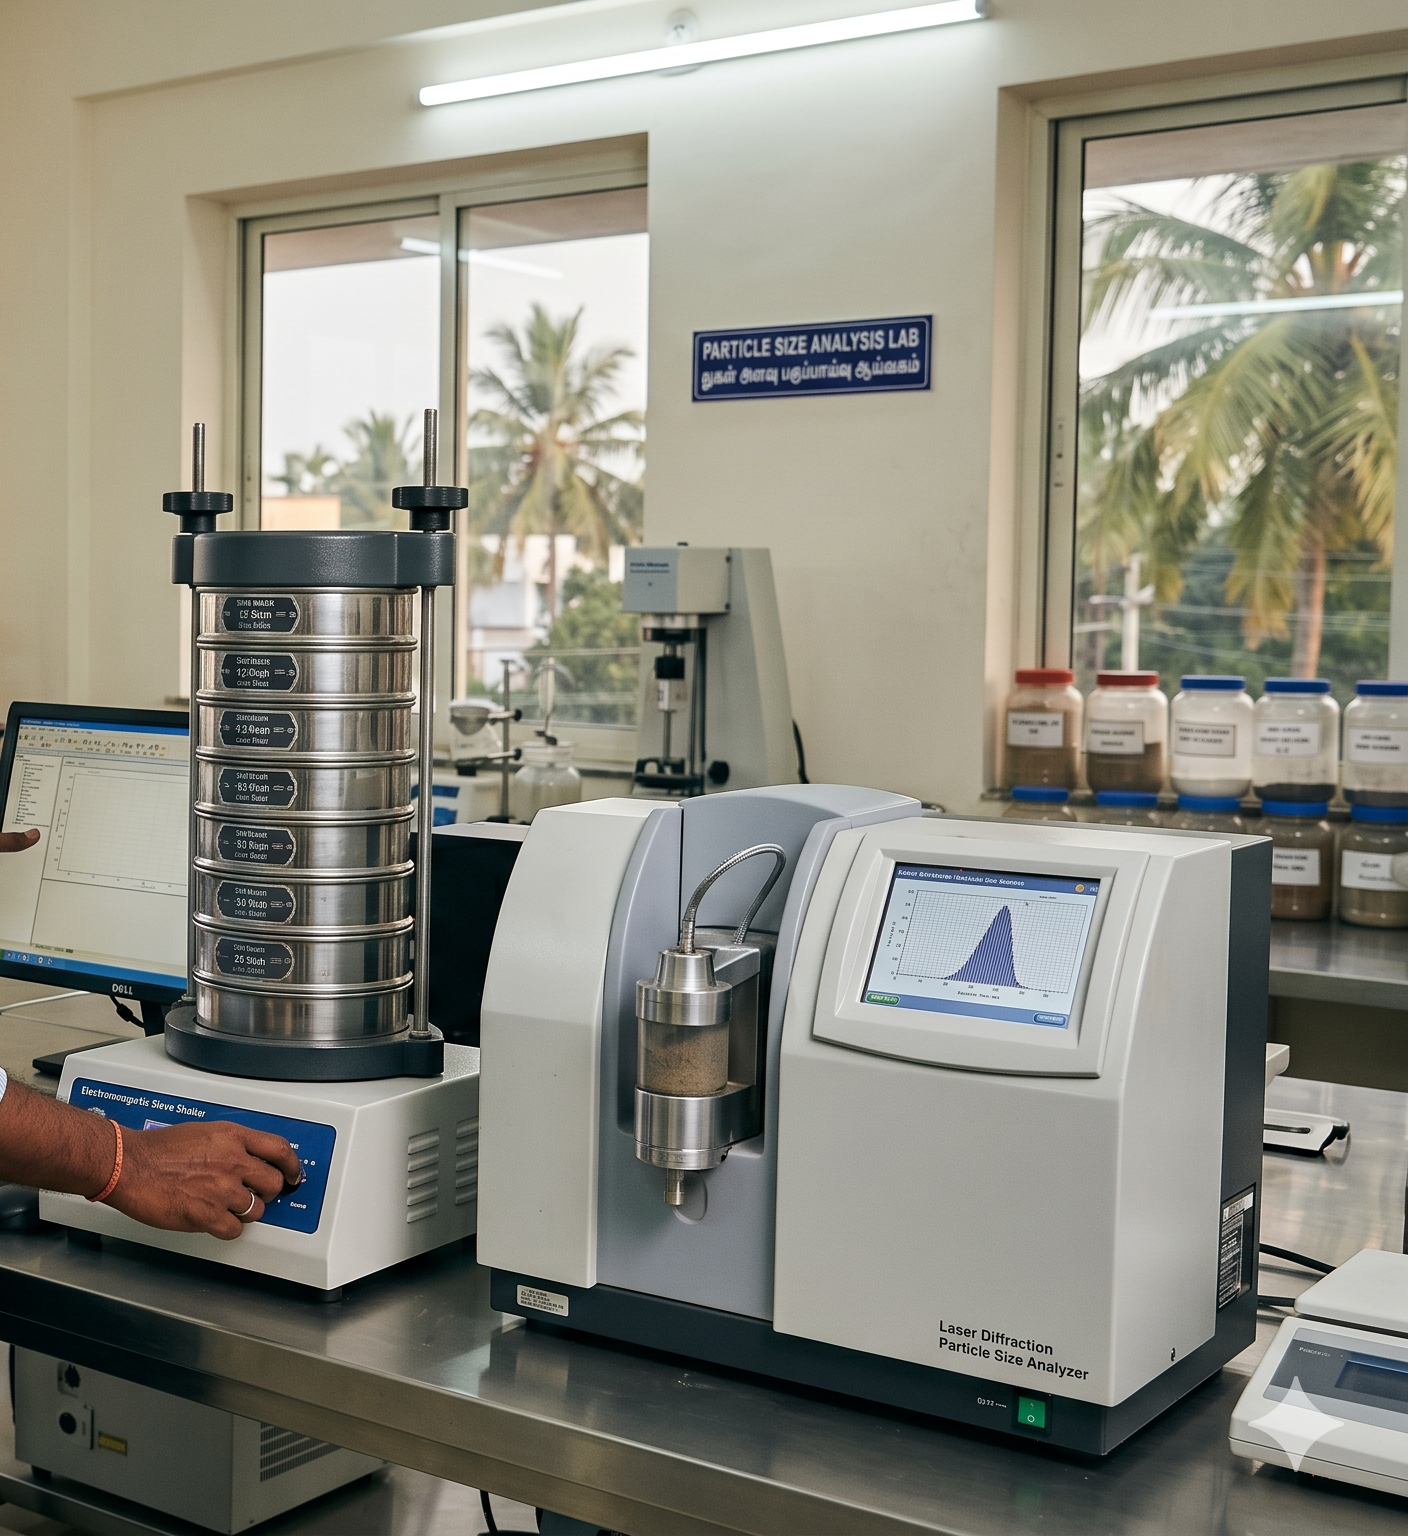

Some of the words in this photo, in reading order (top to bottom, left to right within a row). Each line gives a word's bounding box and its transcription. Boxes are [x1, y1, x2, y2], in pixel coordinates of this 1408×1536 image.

[702, 339, 772, 360] PARTICLE
[775, 335, 807, 356] SIZE
[810, 331, 885, 354] ANALYSIS
[888, 327, 920, 348] LAB
[939, 1319, 978, 1339] Laser
[981, 1328, 1054, 1356] Diffraction
[939, 1337, 990, 1358] Particle
[994, 1349, 1024, 1366] Size
[1027, 1356, 1090, 1381] Analyzer
